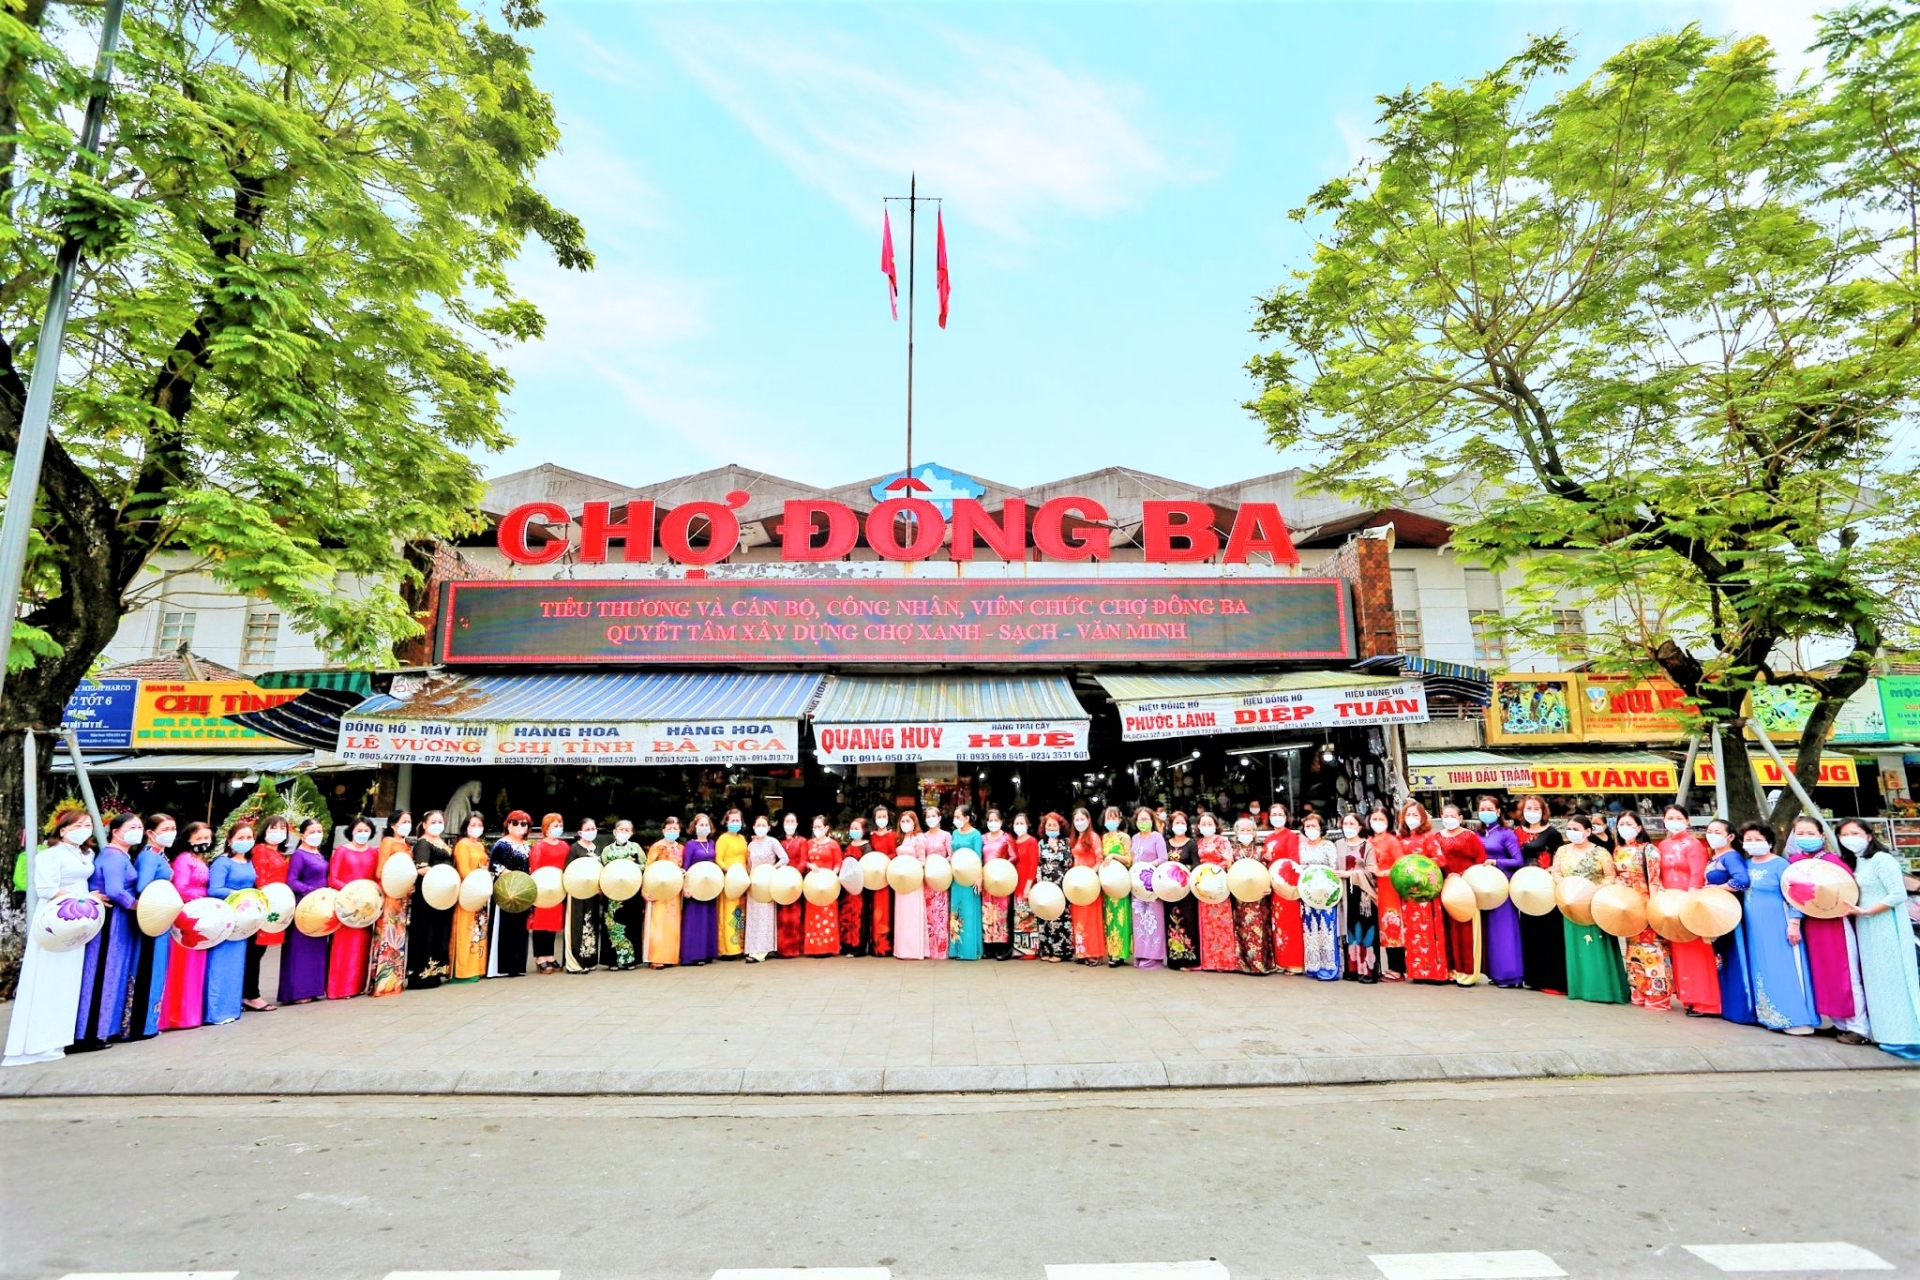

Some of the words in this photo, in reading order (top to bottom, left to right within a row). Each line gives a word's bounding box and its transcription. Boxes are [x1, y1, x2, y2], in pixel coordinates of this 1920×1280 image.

[497, 490, 751, 579] CHỢ
[776, 478, 1110, 562] ĐÔNG
[1142, 497, 1300, 564] BA
[597, 598, 691, 617] THƯƠNG
[696, 597, 725, 617] VÀ
[731, 597, 780, 617] CÁN
[785, 598, 820, 620] BỘ,
[827, 595, 891, 616] CÔNG
[895, 595, 964, 619] NHÂN,
[971, 595, 1024, 616] VIÊN
[1029, 596, 1093, 616] CHỨC
[1099, 598, 1148, 620] CHỢ
[1152, 594, 1215, 616] ĐÔNG
[1220, 599, 1249, 615] BA
[606, 620, 682, 645] QUYẾT
[687, 620, 737, 641] TÂM
[741, 620, 787, 641] XÂY
[792, 622, 858, 645] DỰNG
[863, 623, 914, 645] CHỢ
[918, 624, 981, 641] XANH
[999, 624, 1058, 645] SẠCH
[1076, 619, 1121, 640] VĂN
[1126, 623, 1187, 640] MINH
[81, 692, 104, 706] TỐT
[105, 696, 113, 706] 6
[155, 694, 213, 716] CHỊ
[1333, 695, 1420, 718] TUẤN
[1125, 712, 1174, 732] PHƯỚC
[1176, 711, 1216, 729] LÀNH
[1233, 703, 1315, 725] DIỆP
[420, 724, 452, 736] MÁY
[456, 725, 488, 737] TÍNH
[514, 725, 572, 737] HÀNG
[578, 727, 620, 737] HOA
[666, 724, 725, 736] HÀNG
[731, 724, 774, 735] HOA
[967, 730, 1075, 749] HUỆ
[346, 734, 380, 749] LÊ
[390, 736, 482, 754] VƯƠNG
[497, 741, 551, 757] CHỊ
[561, 738, 635, 753] TÌNH
[651, 737, 701, 753] BÀ
[712, 738, 787, 752] NGA
[821, 727, 894, 755] QUANG
[901, 726, 944, 748] HUY
[905, 753, 923, 762] 374
[1447, 770, 1473, 784] TINH
[1499, 767, 1531, 782] TRÀM
[1580, 767, 1670, 788] VÀNG
